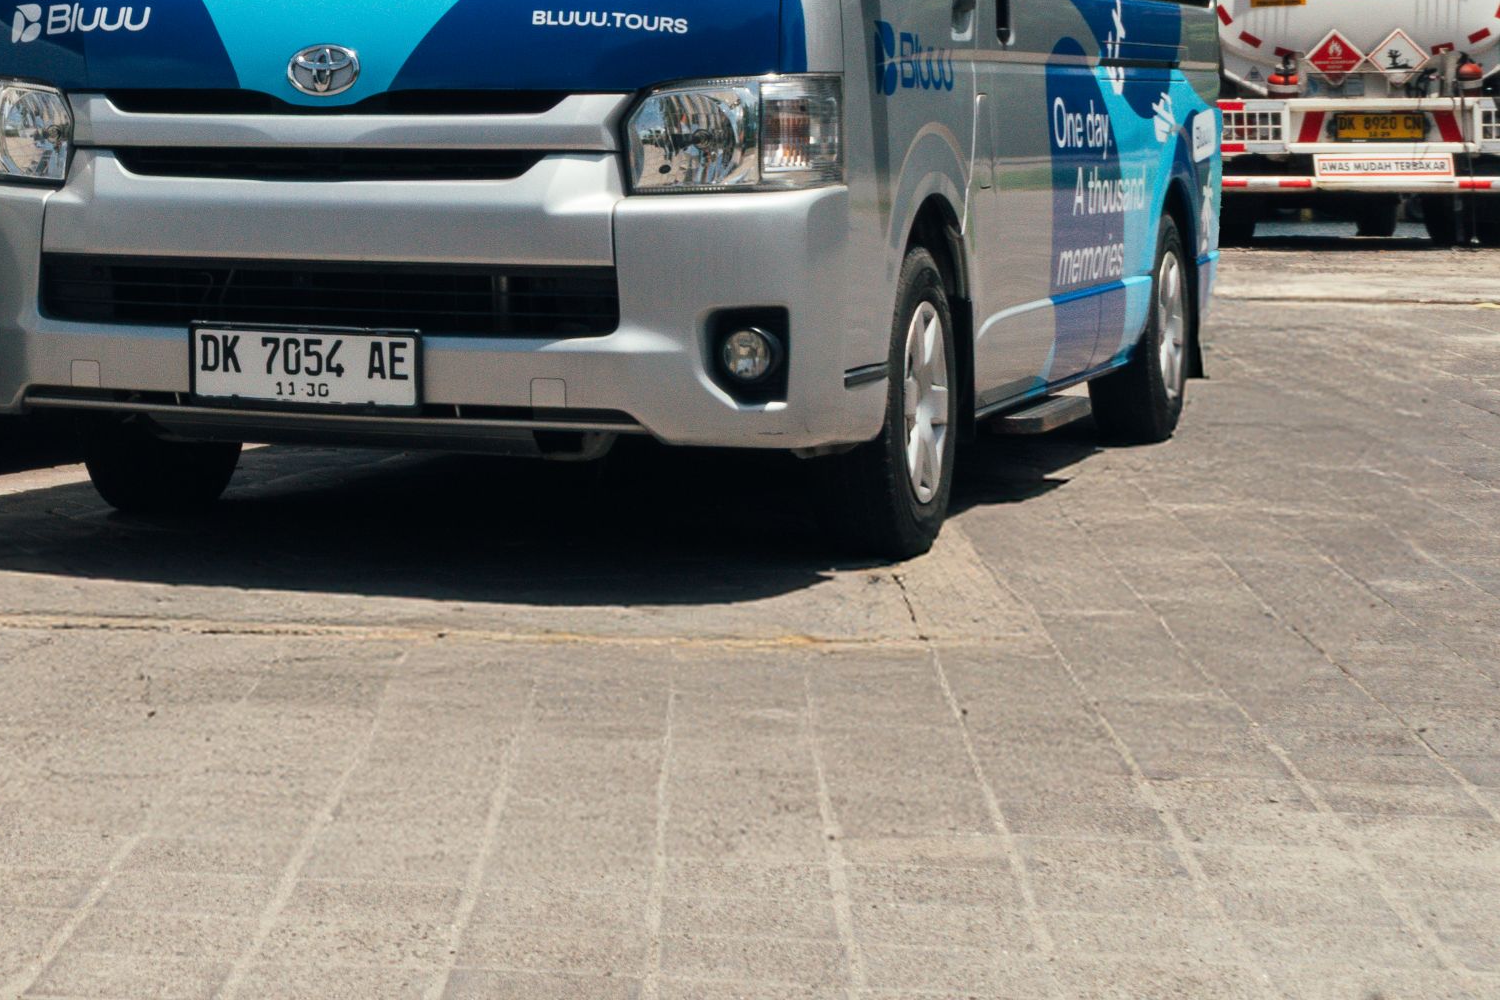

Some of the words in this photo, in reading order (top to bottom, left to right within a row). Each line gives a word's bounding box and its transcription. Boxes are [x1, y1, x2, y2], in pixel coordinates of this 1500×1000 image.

[46, 2, 151, 35] Bluuu
[531, 10, 688, 34] BLUUU.TOURS
[900, 32, 953, 92] Bluuu
[1054, 97, 1084, 148] One
[1086, 100, 1113, 160] day.
[1339, 116, 1356, 130] DK
[1321, 162, 1351, 172] AWAS
[1354, 161, 1392, 171] MUDAH
[1394, 160, 1447, 171] TERBAKAR
[1072, 166, 1085, 217] A
[1088, 163, 1146, 215] thousand
[200, 334, 242, 374] DK
[261, 336, 345, 378] 7054
[367, 341, 409, 381] AE
